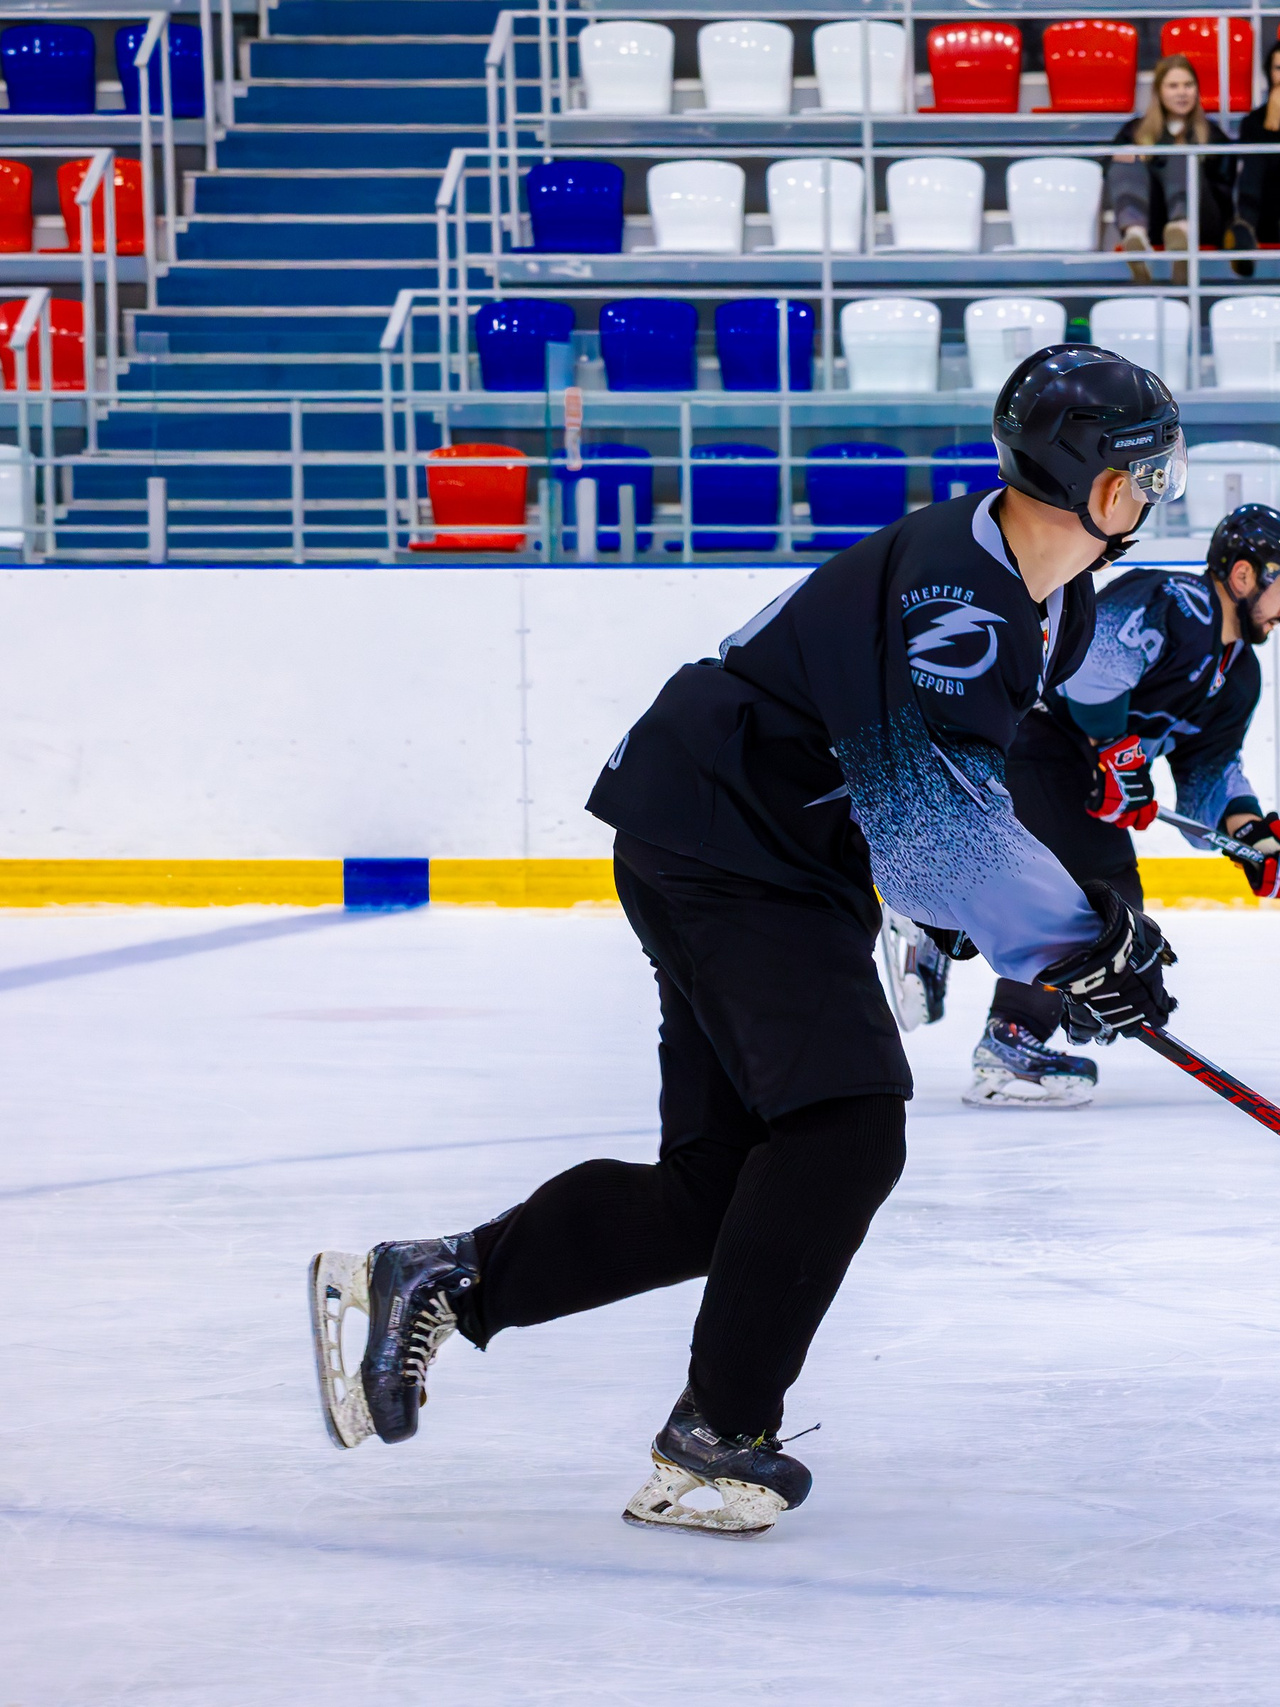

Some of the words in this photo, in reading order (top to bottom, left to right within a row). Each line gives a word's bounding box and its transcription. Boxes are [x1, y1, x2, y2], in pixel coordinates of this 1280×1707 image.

[1114, 434, 1154, 448] BAUER
[901, 585, 975, 609] ЭНЕРГИЯ
[1202, 832, 1240, 852] ACE
